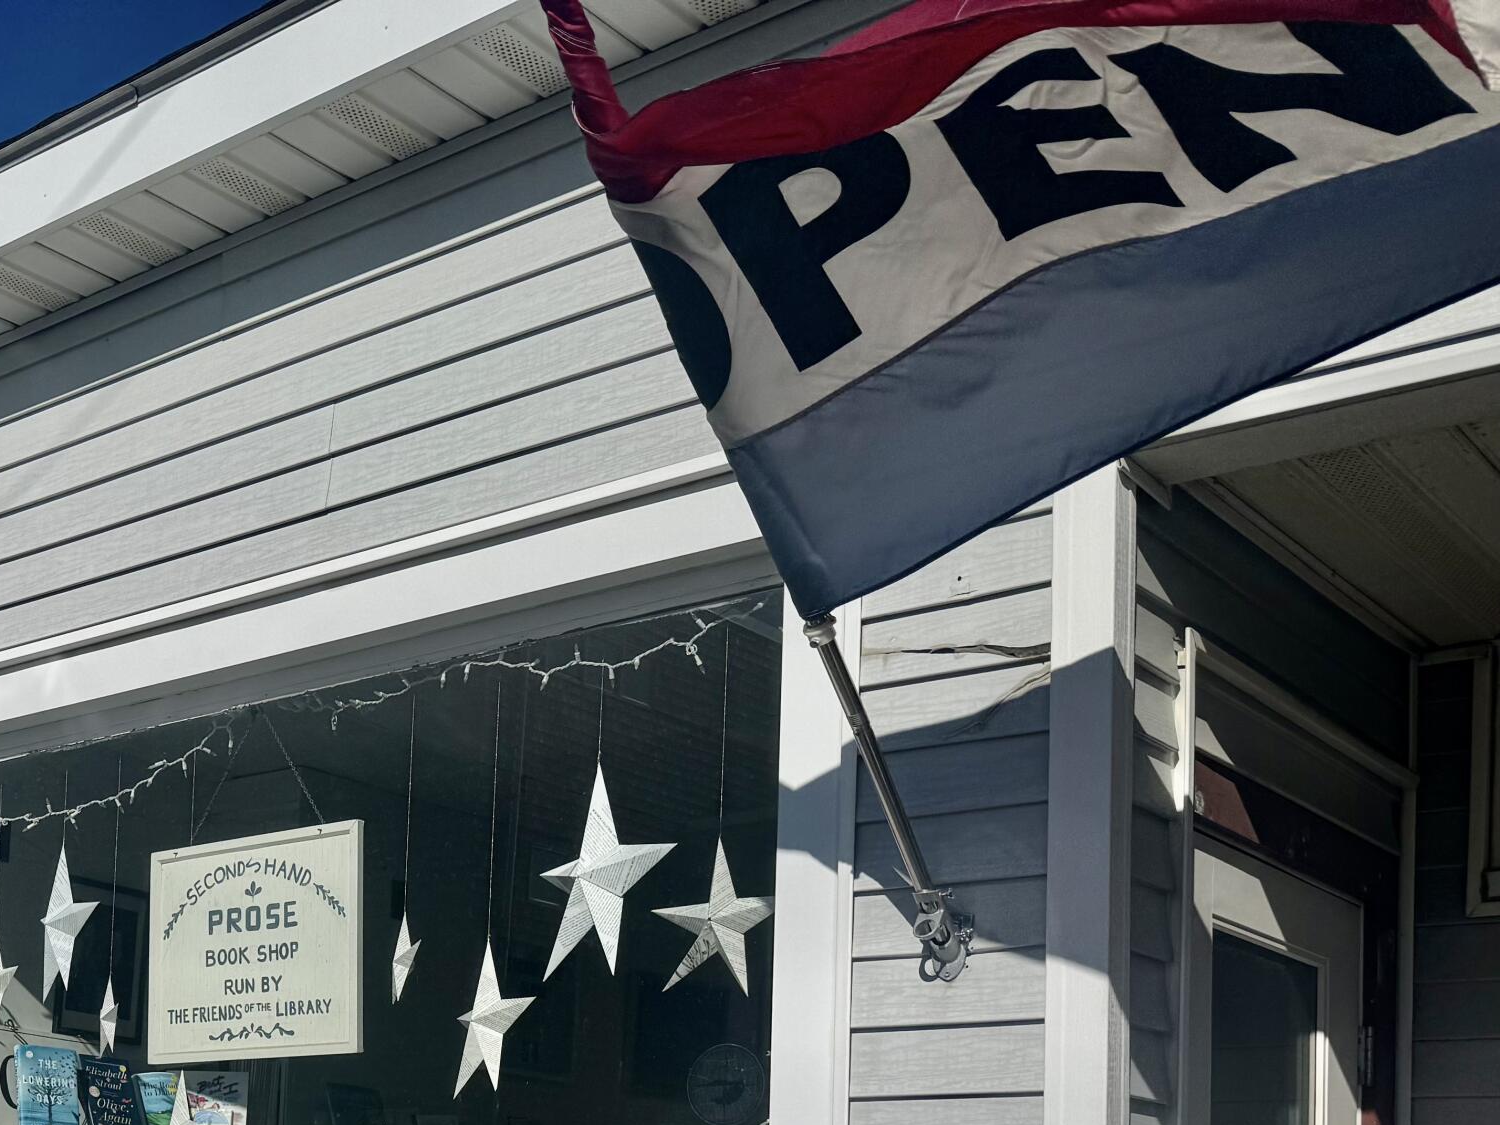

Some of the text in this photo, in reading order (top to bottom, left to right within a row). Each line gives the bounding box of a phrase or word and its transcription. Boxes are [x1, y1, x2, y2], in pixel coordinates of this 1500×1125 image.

[208, 901, 299, 936] PROSE
[205, 941, 299, 968] BOOK SHOP
[224, 975, 283, 996] RUN BY
[167, 998, 333, 1025] THE FRIENDS OF THE LIBRARY
[37, 1058, 58, 1070] THE
[85, 1065, 128, 1080] Elizabeth
[21, 1074, 76, 1089] LOWERING
[36, 1093, 63, 1105] DAYS
[100, 1111, 133, 1125] Again
